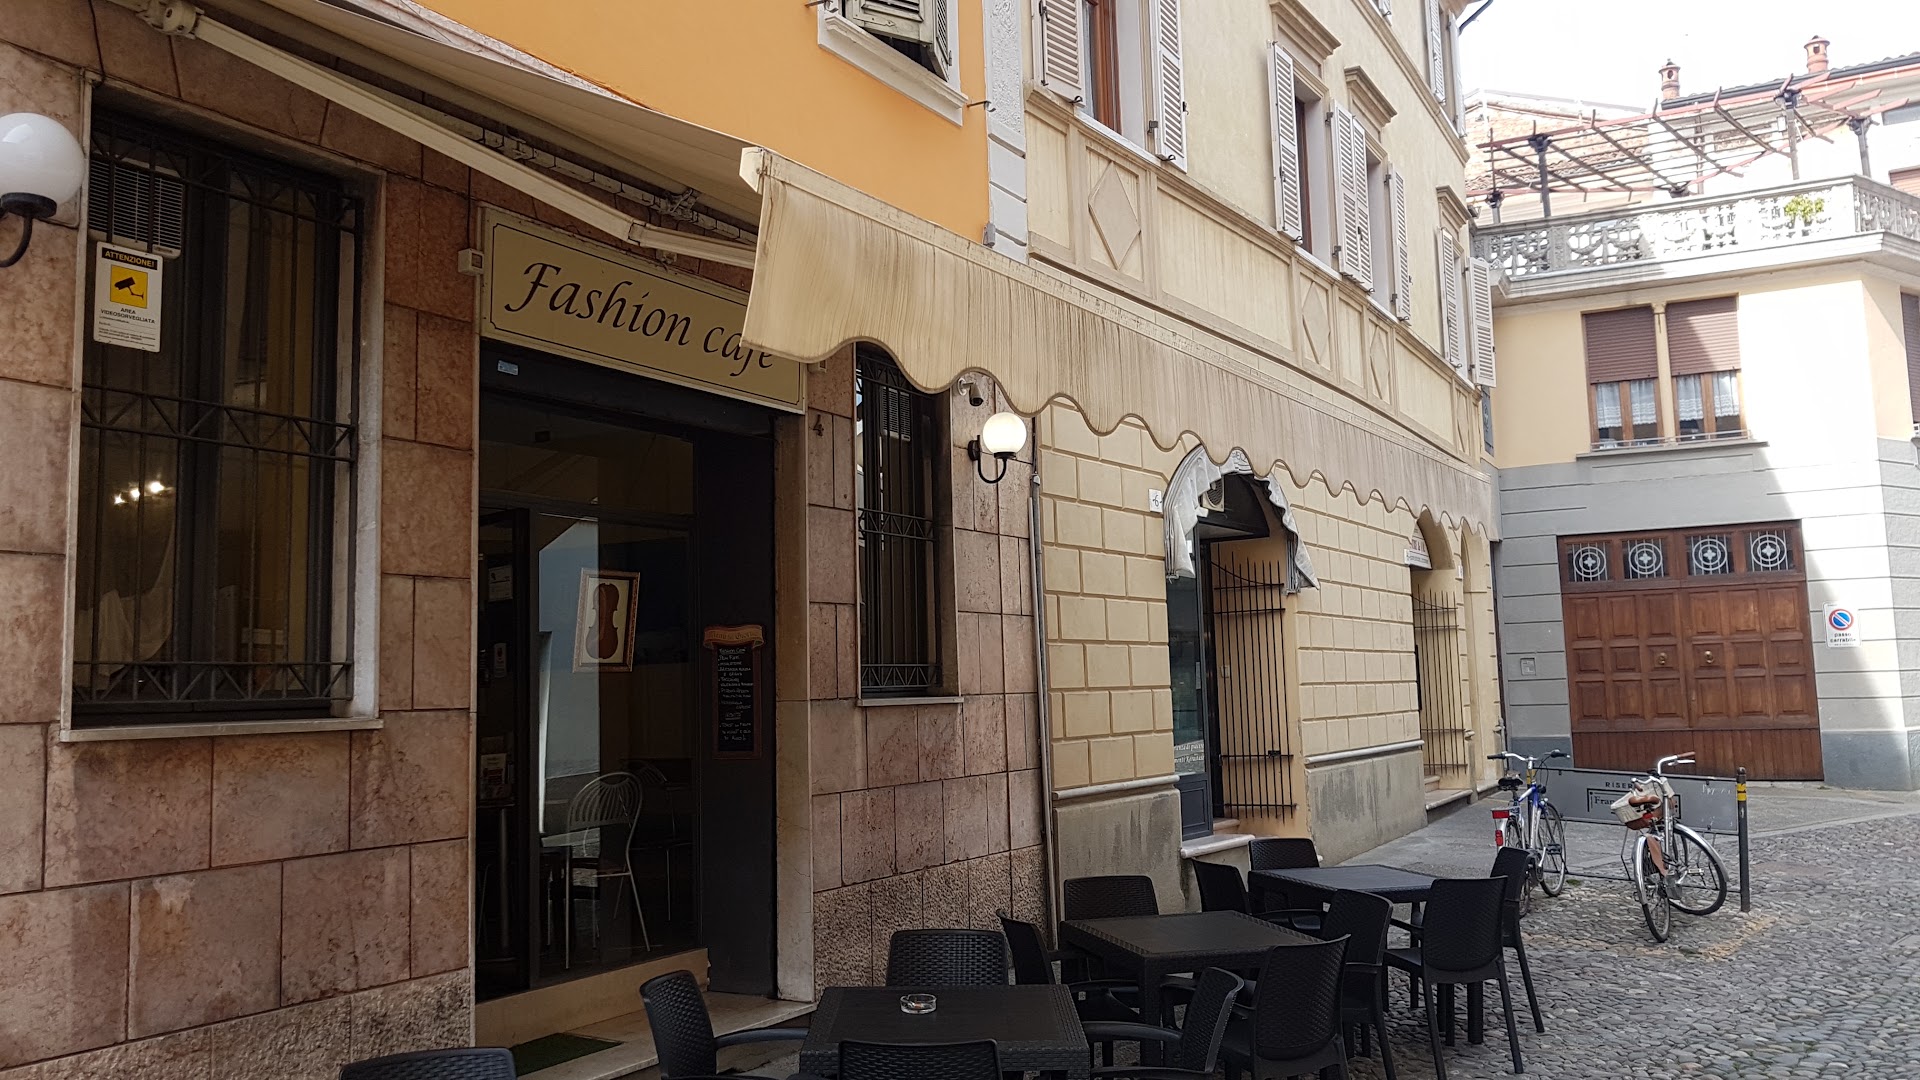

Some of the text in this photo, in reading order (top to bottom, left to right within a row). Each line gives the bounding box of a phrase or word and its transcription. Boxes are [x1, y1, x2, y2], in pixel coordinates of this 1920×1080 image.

[105, 250, 155, 267] ATTENZIONE!
[120, 307, 136, 315] AREA
[504, 262, 691, 346] Fashion
[100, 309, 156, 324] VIDEOSORVEGLIATA
[1605, 781, 1633, 789] RISER
